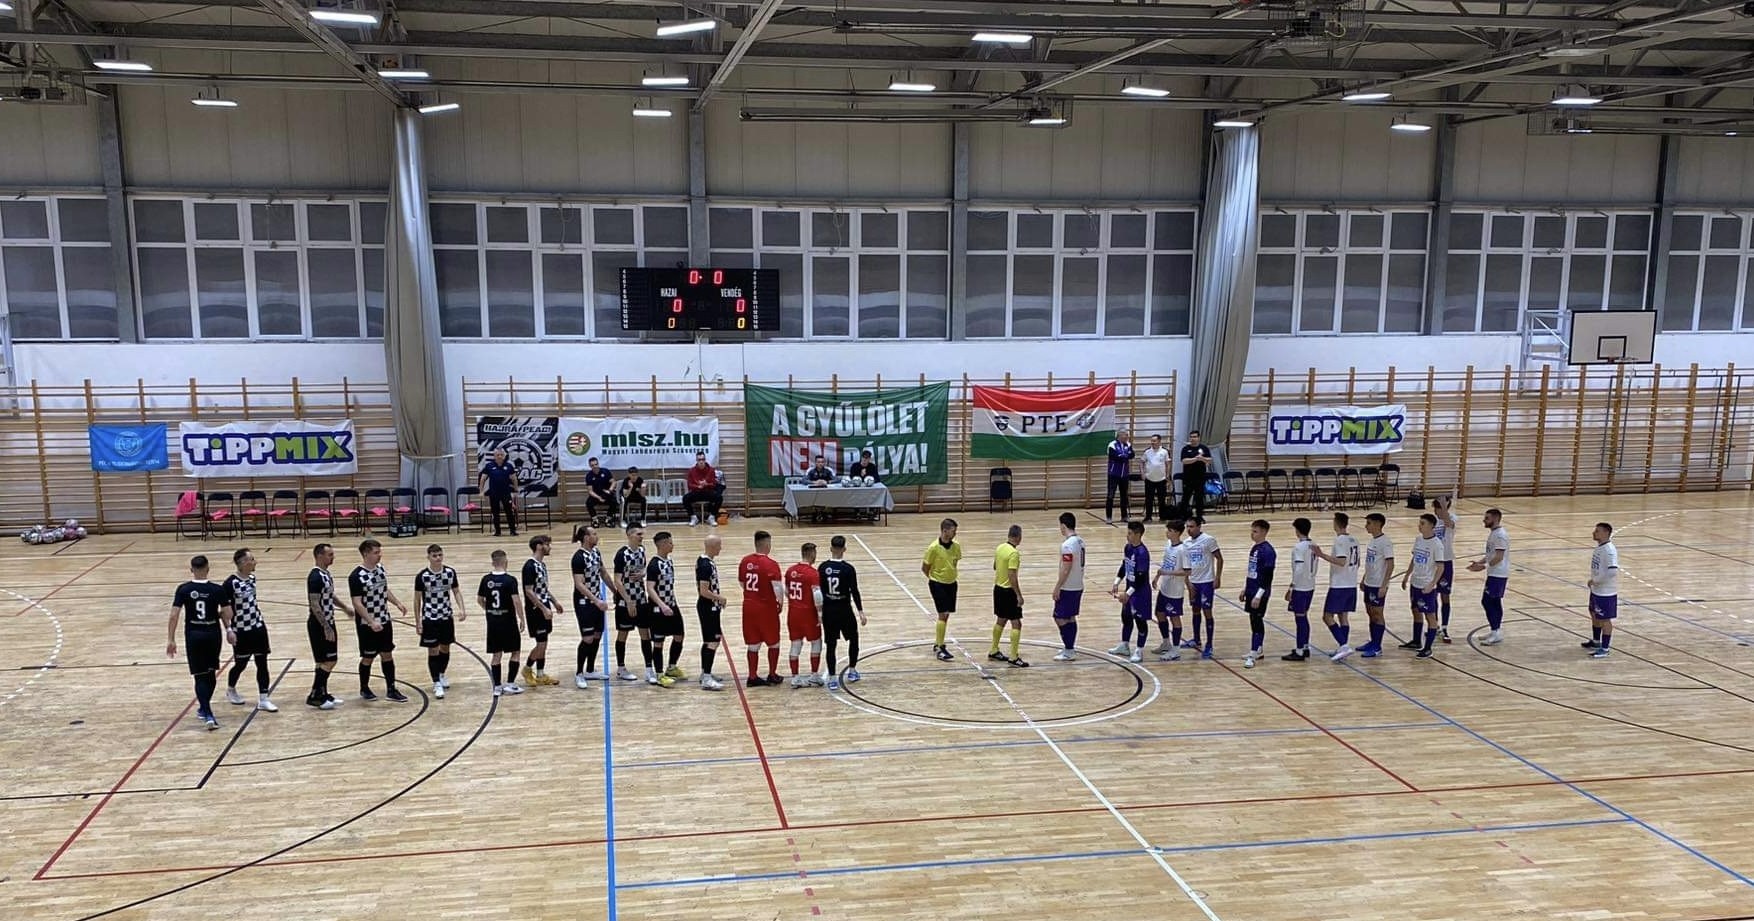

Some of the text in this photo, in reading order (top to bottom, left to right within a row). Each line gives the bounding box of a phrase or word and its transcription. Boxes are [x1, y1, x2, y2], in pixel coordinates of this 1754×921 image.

[720, 286, 742, 298] VENDÉG
[674, 299, 682, 312] 0
[736, 299, 745, 312] 0
[668, 317, 676, 328] 0
[738, 318, 745, 328] 0
[771, 400, 929, 437] A GYŰLÖLET
[1021, 415, 1068, 433] PTE
[601, 430, 710, 448] mlsz.hu
[771, 440, 837, 476] NEM
[746, 573, 759, 592] 22
[790, 581, 802, 600] 55
[827, 576, 840, 594] 12
[491, 590, 500, 608] 3
[196, 600, 206, 619] 9
